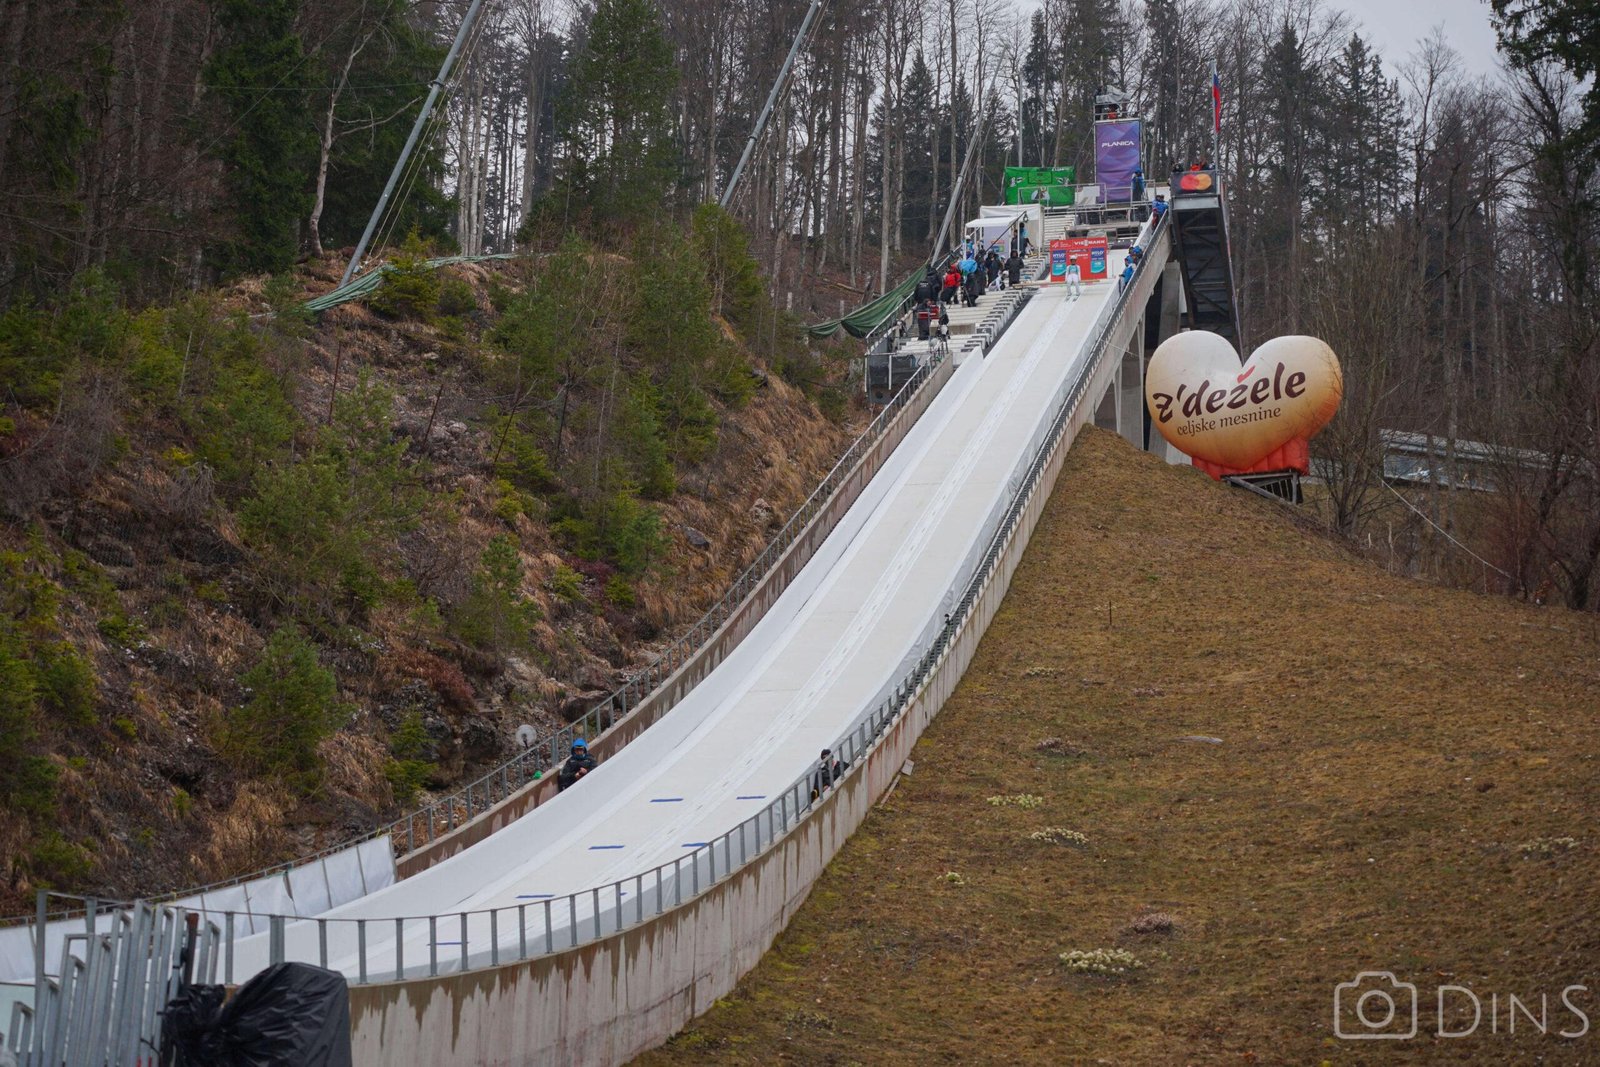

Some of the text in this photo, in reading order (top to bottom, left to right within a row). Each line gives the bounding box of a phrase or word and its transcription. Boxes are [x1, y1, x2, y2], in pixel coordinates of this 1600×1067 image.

[1101, 140, 1135, 148] PLANICA
[1177, 405, 1281, 437] celjske mesnine
